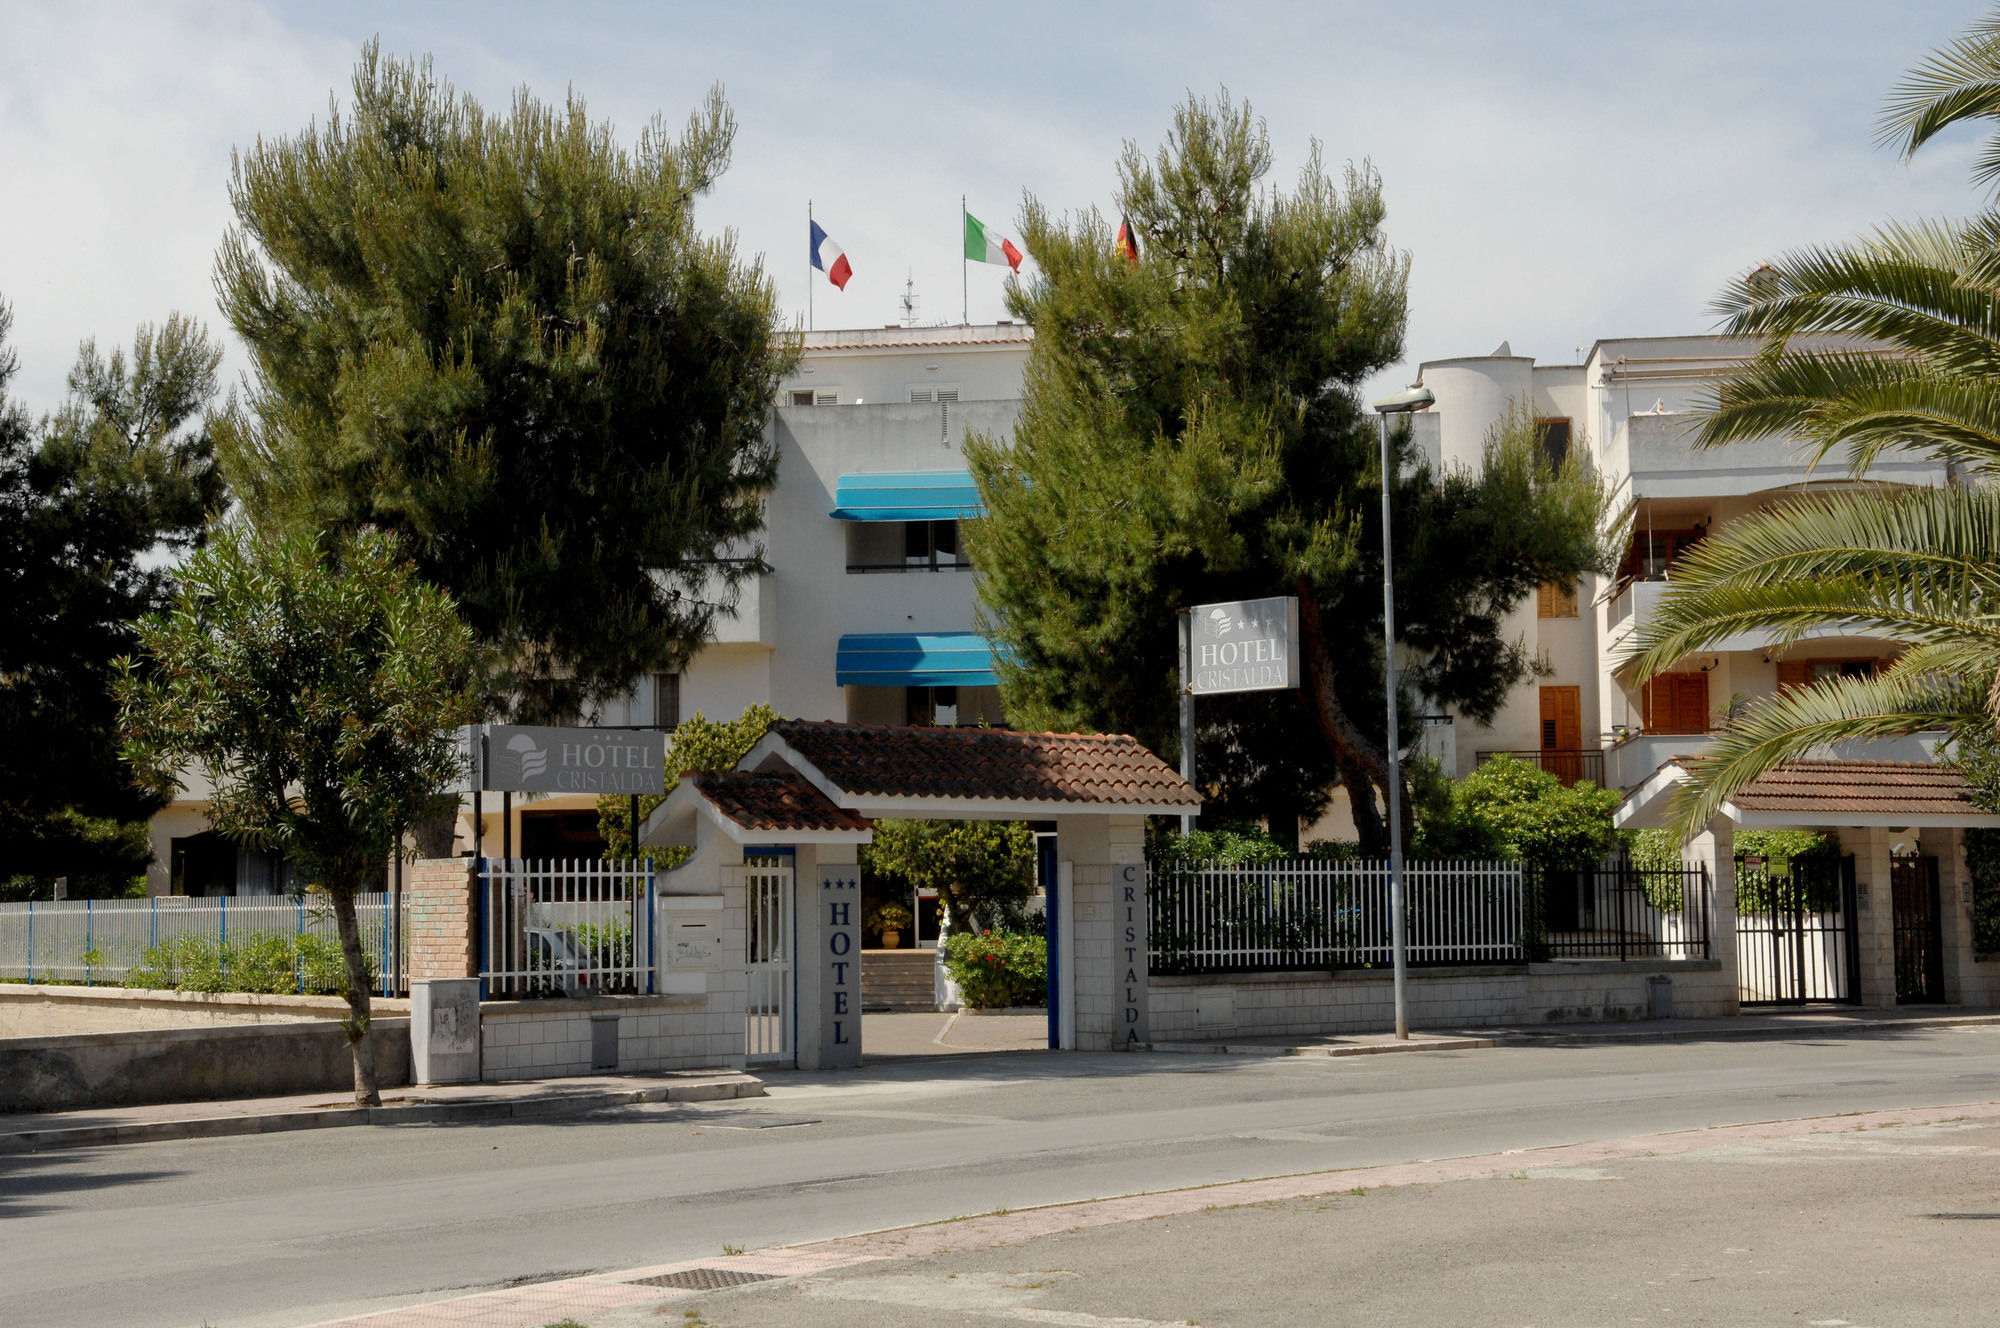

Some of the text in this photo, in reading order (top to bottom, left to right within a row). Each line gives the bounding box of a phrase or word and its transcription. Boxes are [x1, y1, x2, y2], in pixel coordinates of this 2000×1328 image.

[1200, 639, 1282, 667] HOTEL
[1197, 666, 1282, 690] CRISTALDA
[562, 744, 656, 769] HOTEL
[557, 771, 656, 792] CRISTALDA
[1123, 867, 1139, 1043] CRISTALDA
[829, 902, 851, 1044] HOTEL
